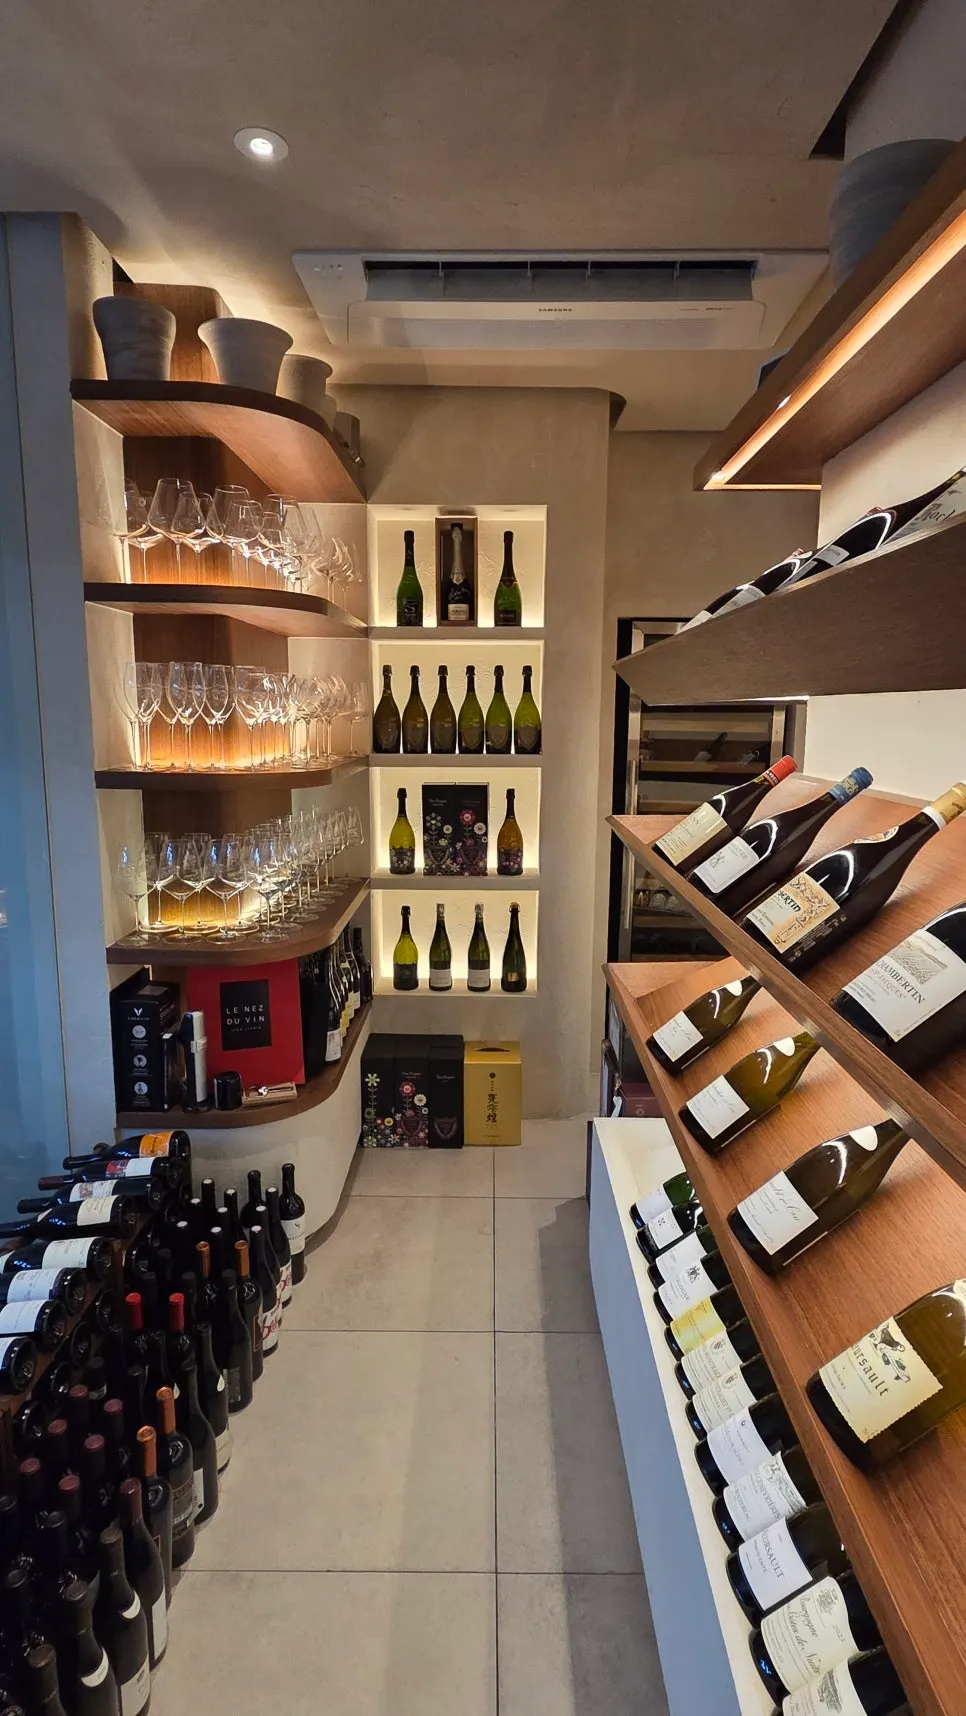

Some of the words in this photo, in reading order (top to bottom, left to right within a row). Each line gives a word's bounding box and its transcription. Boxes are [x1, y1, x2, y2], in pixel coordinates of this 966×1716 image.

[226, 1006, 239, 1015] LE
[244, 1004, 264, 1013] NEZ
[226, 1018, 240, 1026] DU
[245, 1015, 265, 1024] VIN
